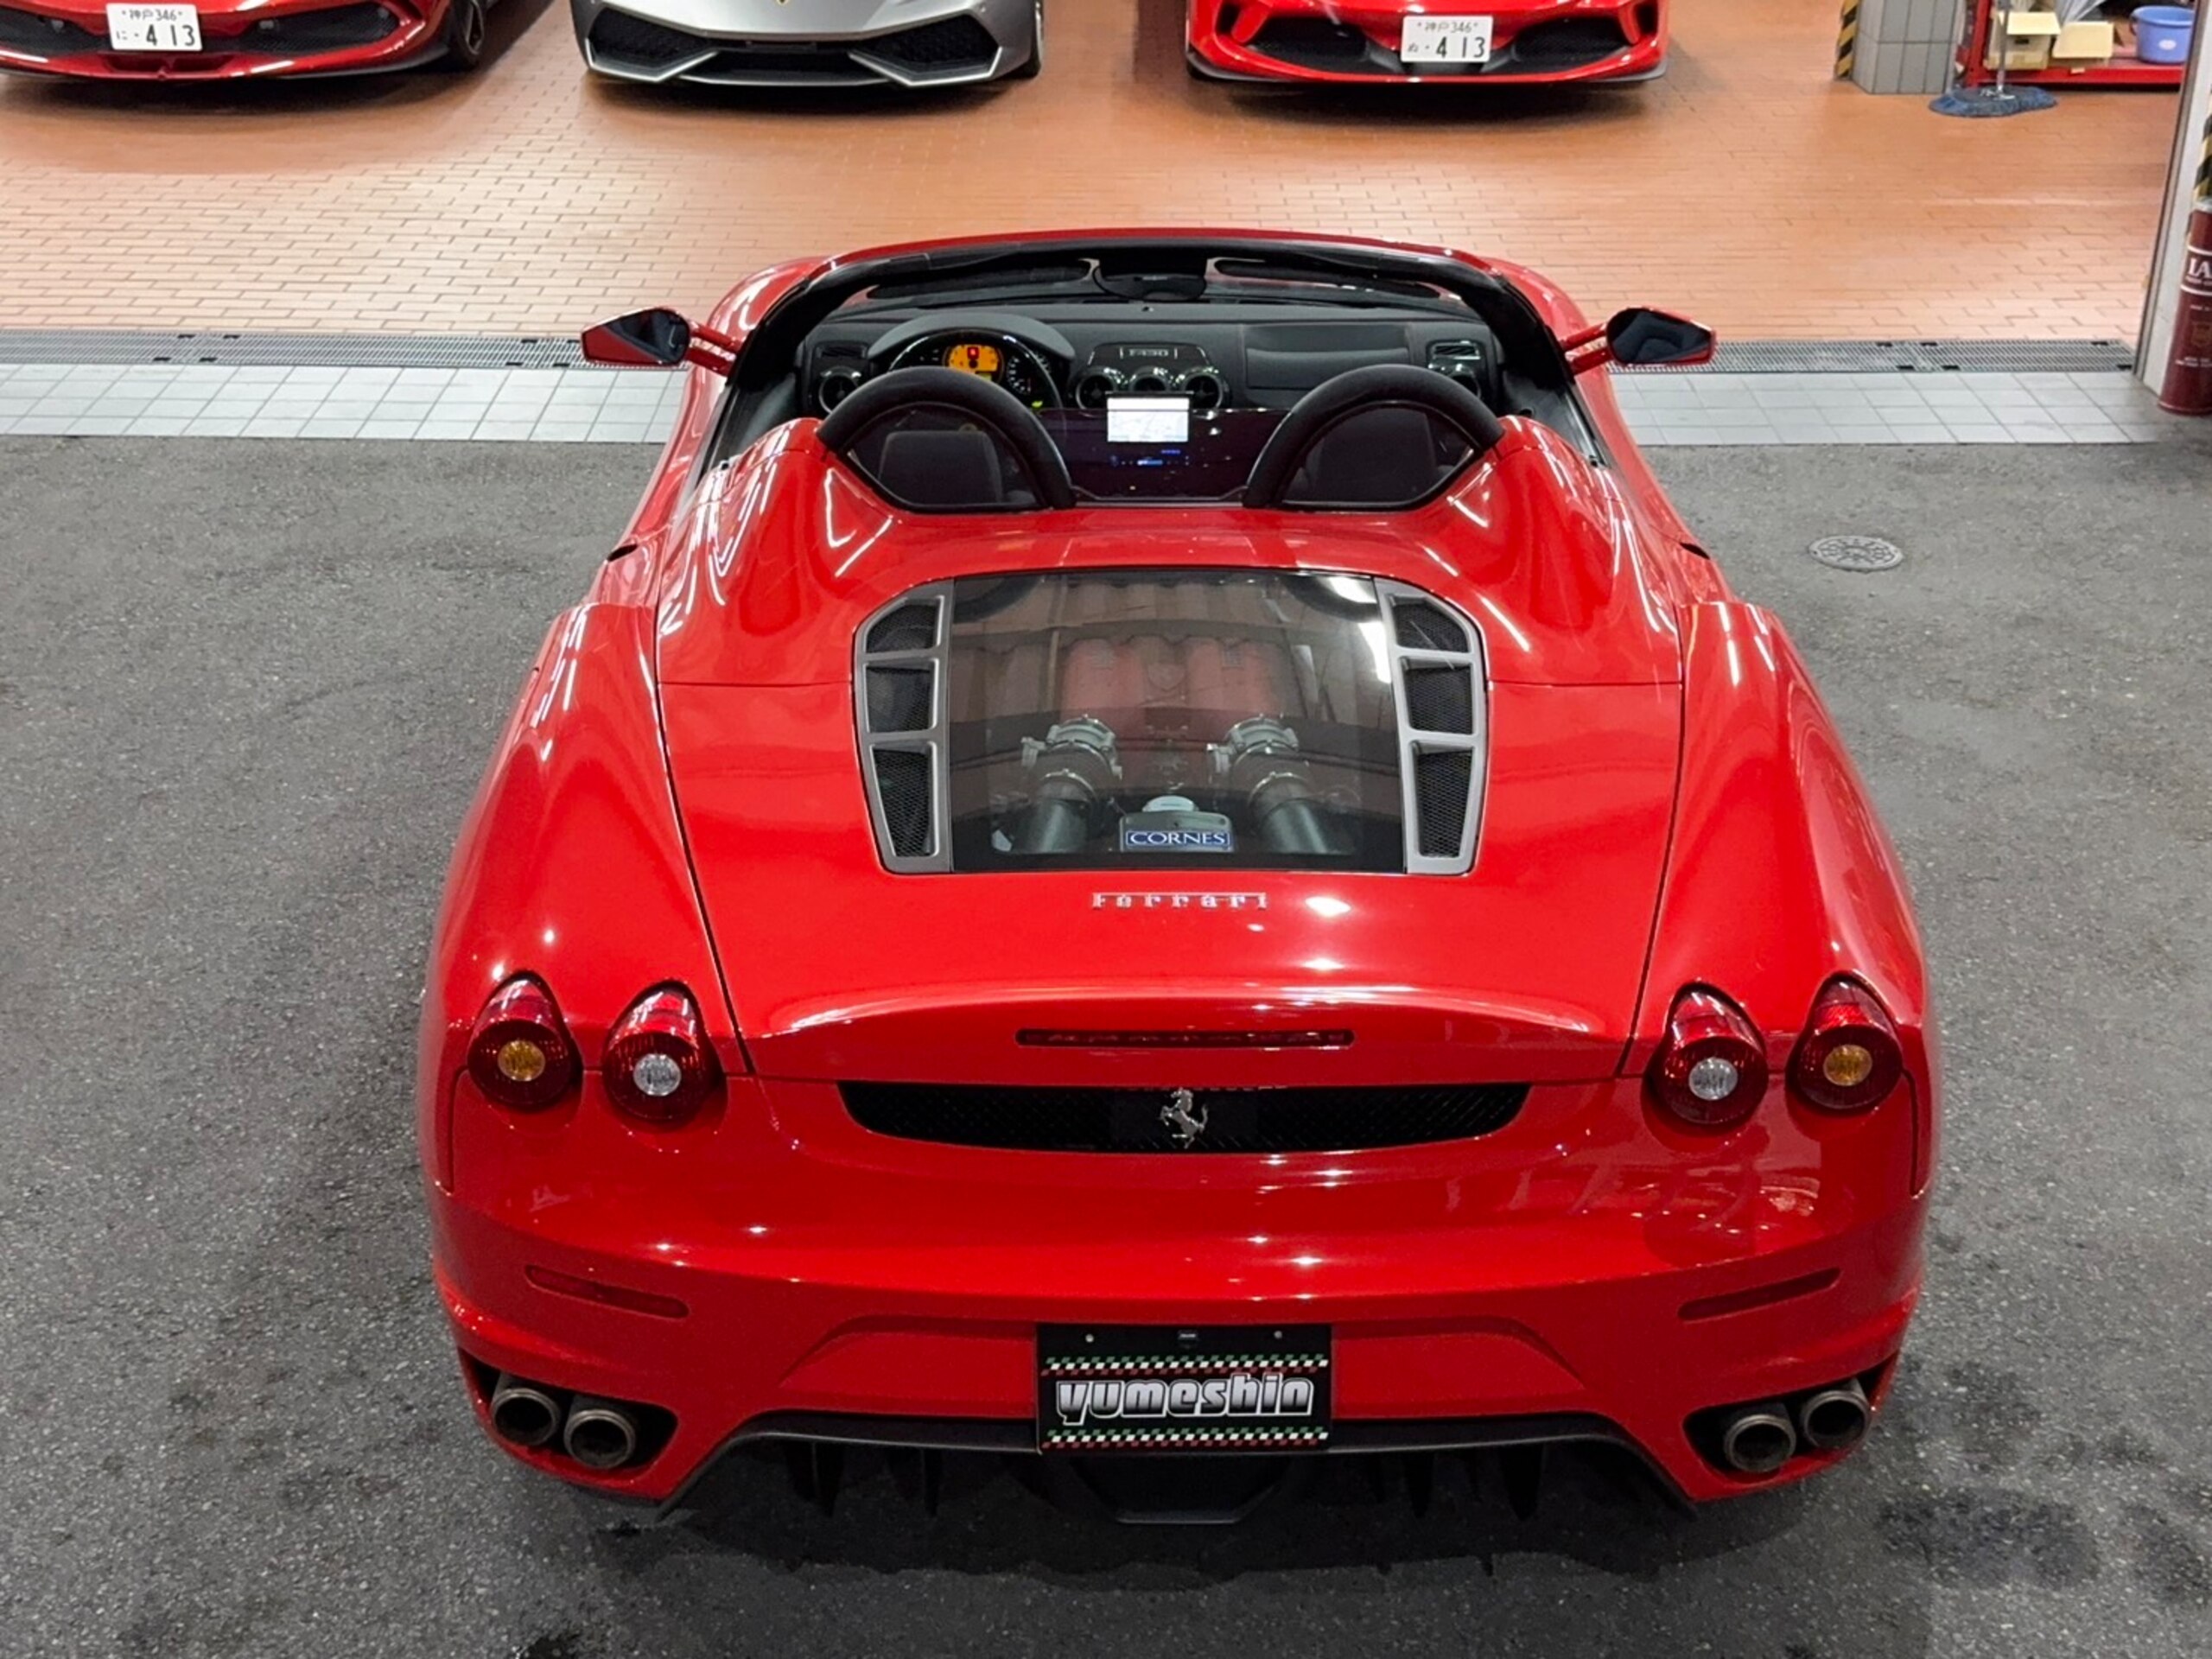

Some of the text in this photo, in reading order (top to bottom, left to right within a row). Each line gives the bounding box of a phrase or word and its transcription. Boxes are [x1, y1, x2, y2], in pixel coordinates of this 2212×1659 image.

[1130, 832, 1225, 845] CORNES
[1092, 892, 1267, 910] Ferrari
[1056, 1372, 1313, 1426] yumeshin
